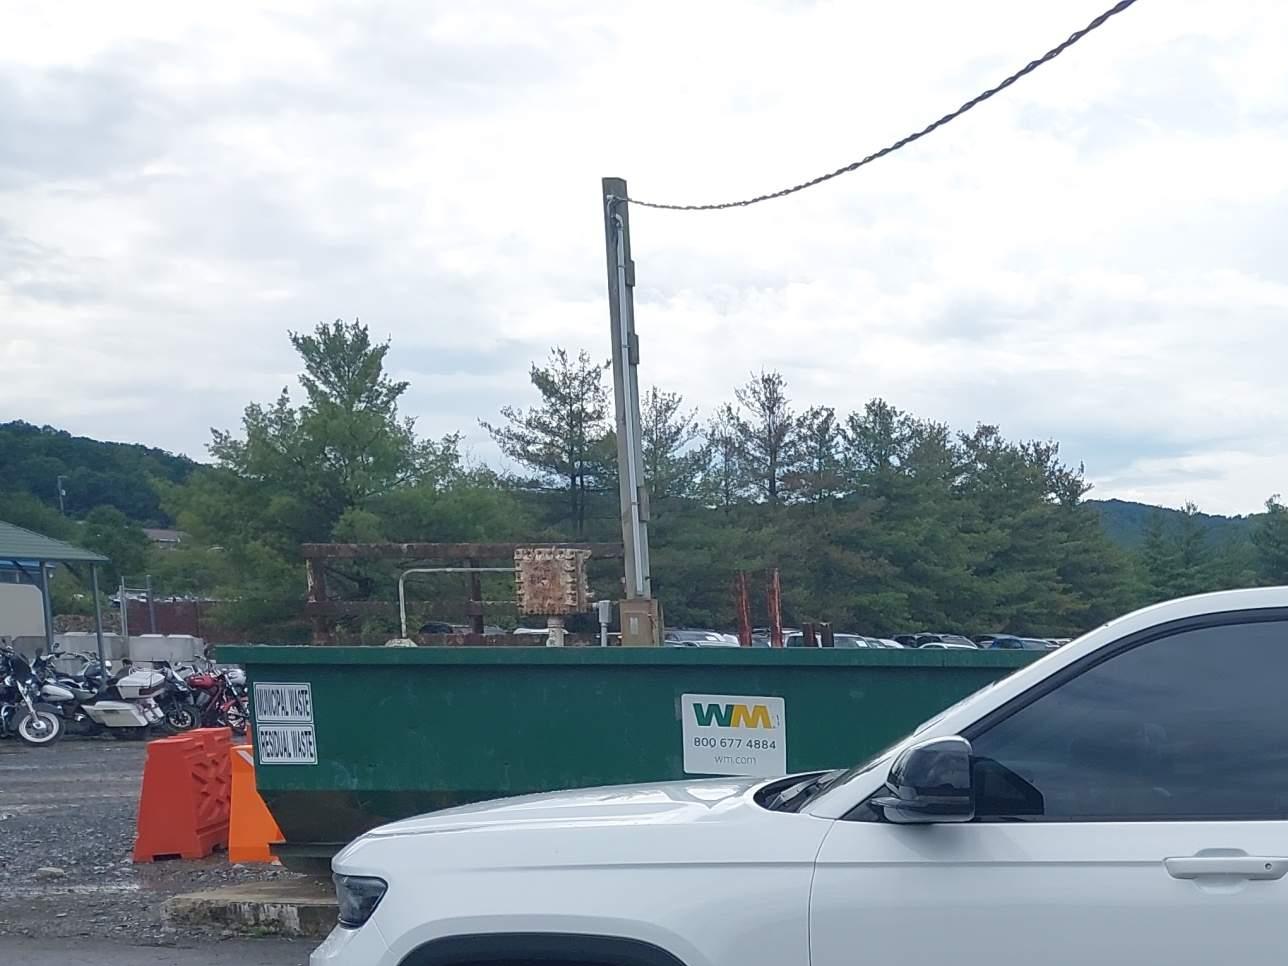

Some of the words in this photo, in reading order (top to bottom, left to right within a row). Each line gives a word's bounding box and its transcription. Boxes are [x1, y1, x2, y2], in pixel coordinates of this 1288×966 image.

[256, 688, 289, 716] MUNICIPAL
[288, 688, 310, 716] WASTE
[692, 703, 772, 729] WM
[260, 730, 292, 758] RESIDUAL
[290, 730, 314, 758] WASTE
[694, 737, 717, 748] 800
[719, 738, 742, 749] 677
[746, 739, 777, 750] 4884
[714, 755, 757, 765] wm.com
